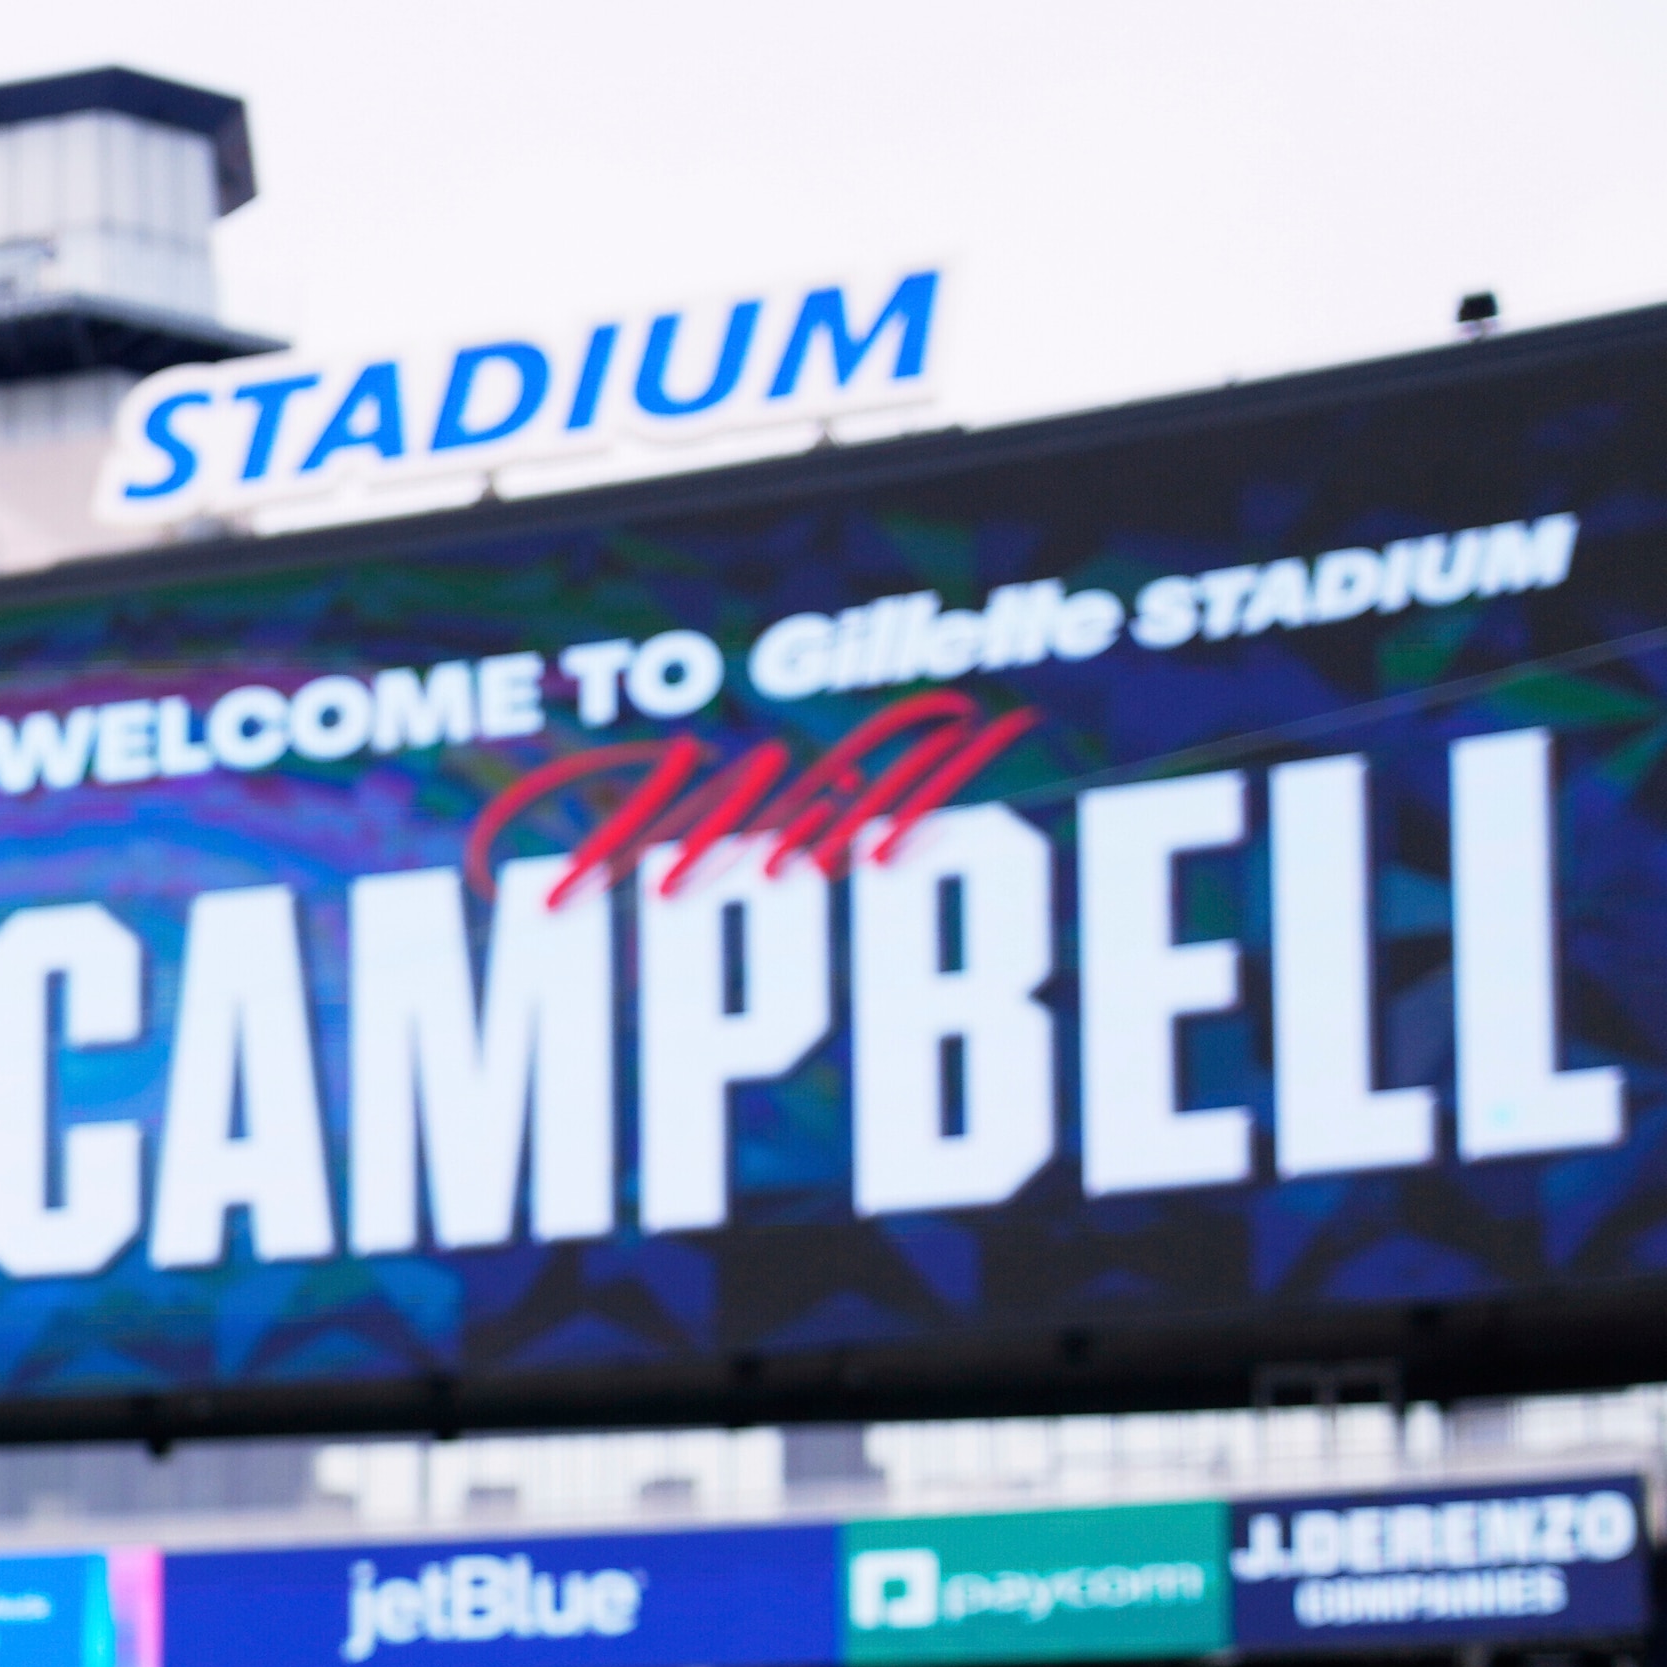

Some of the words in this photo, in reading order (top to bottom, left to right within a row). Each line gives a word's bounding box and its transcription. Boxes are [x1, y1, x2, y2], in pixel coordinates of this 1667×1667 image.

[120, 268, 941, 502] STADIUM
[562, 629, 723, 724] TO
[748, 576, 1124, 703] Gillette
[1130, 515, 1579, 651] STADIUM
[465, 686, 1044, 914] Will
[341, 1552, 643, 1662] jetBlue
[941, 1557, 1207, 1622] paycom
